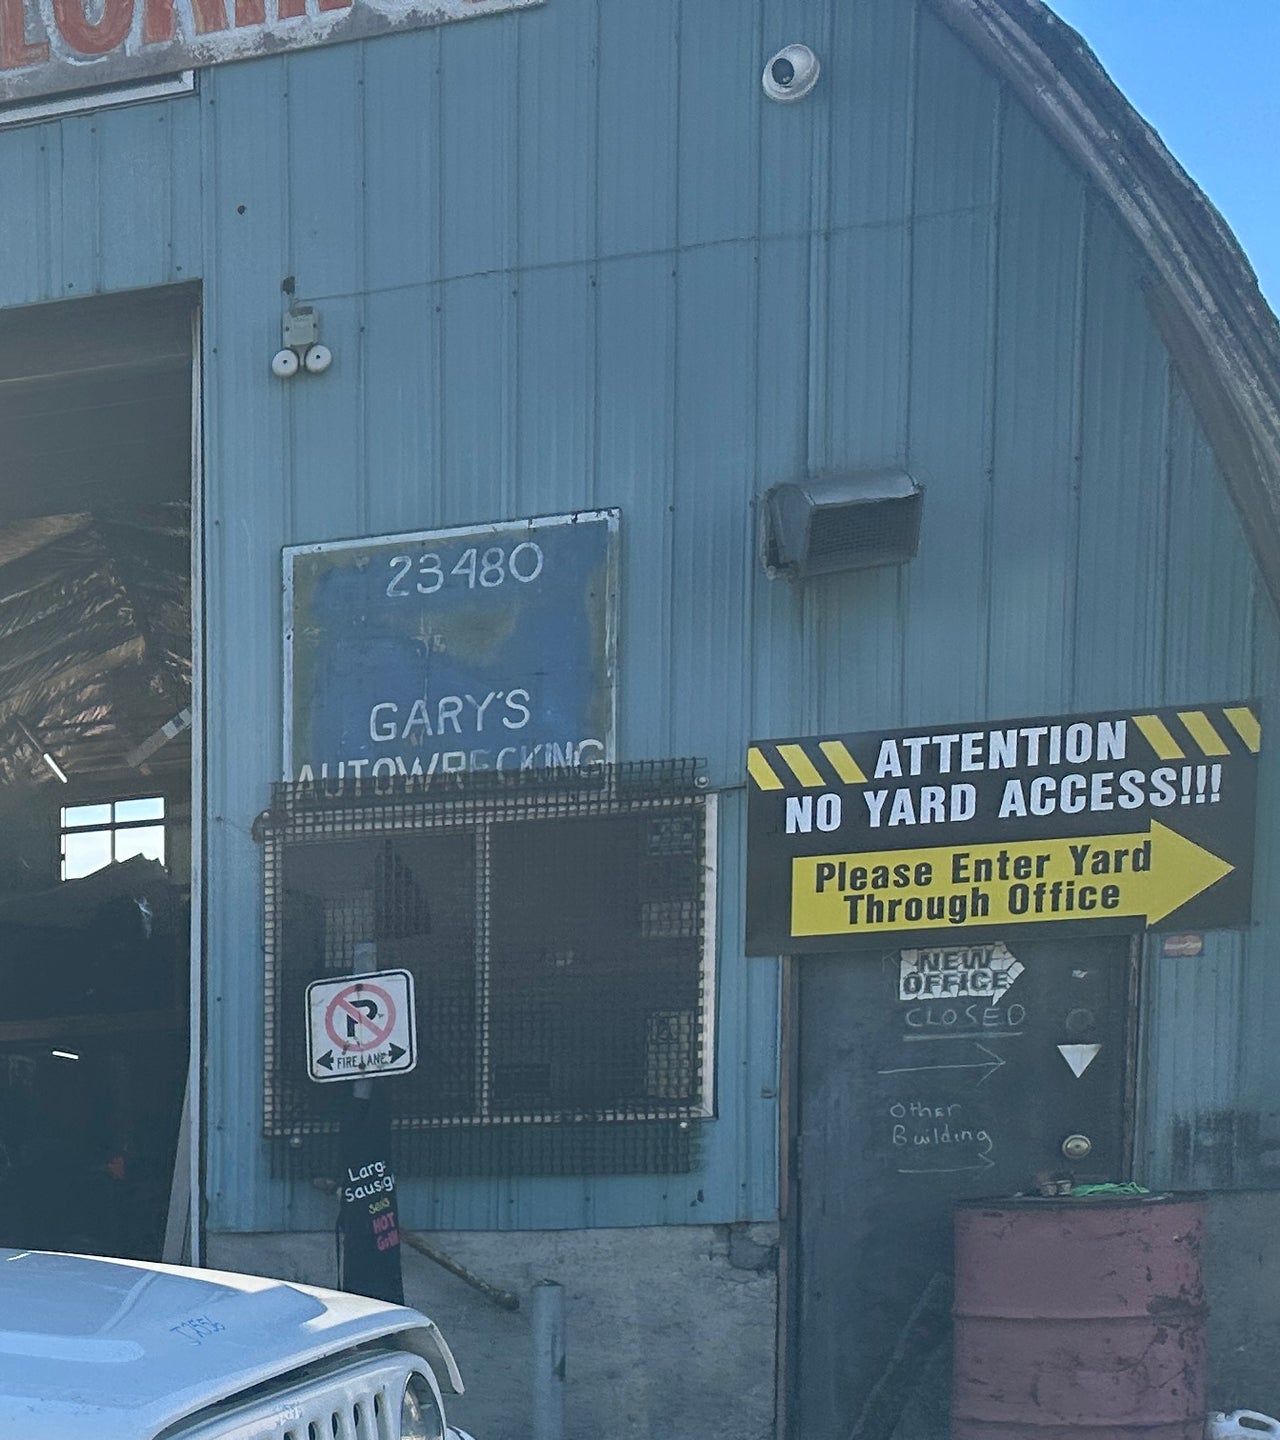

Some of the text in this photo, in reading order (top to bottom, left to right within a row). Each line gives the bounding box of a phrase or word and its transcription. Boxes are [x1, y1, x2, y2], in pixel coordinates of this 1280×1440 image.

[386, 542, 544, 598] 23480
[369, 688, 531, 742] GARY'S
[874, 719, 1128, 779] ATTENTION
[785, 763, 1223, 834] NO YARD ACCESS!!!
[815, 840, 1153, 894] Please Enter Yard
[844, 884, 1121, 925] Through Office
[918, 950, 993, 972] NEW
[903, 971, 1010, 995] OFFICE
[905, 1003, 1027, 1028] CLOSED
[337, 1054, 357, 1069] FIRE
[889, 1101, 962, 1120] Other
[892, 1124, 994, 1155] Building
